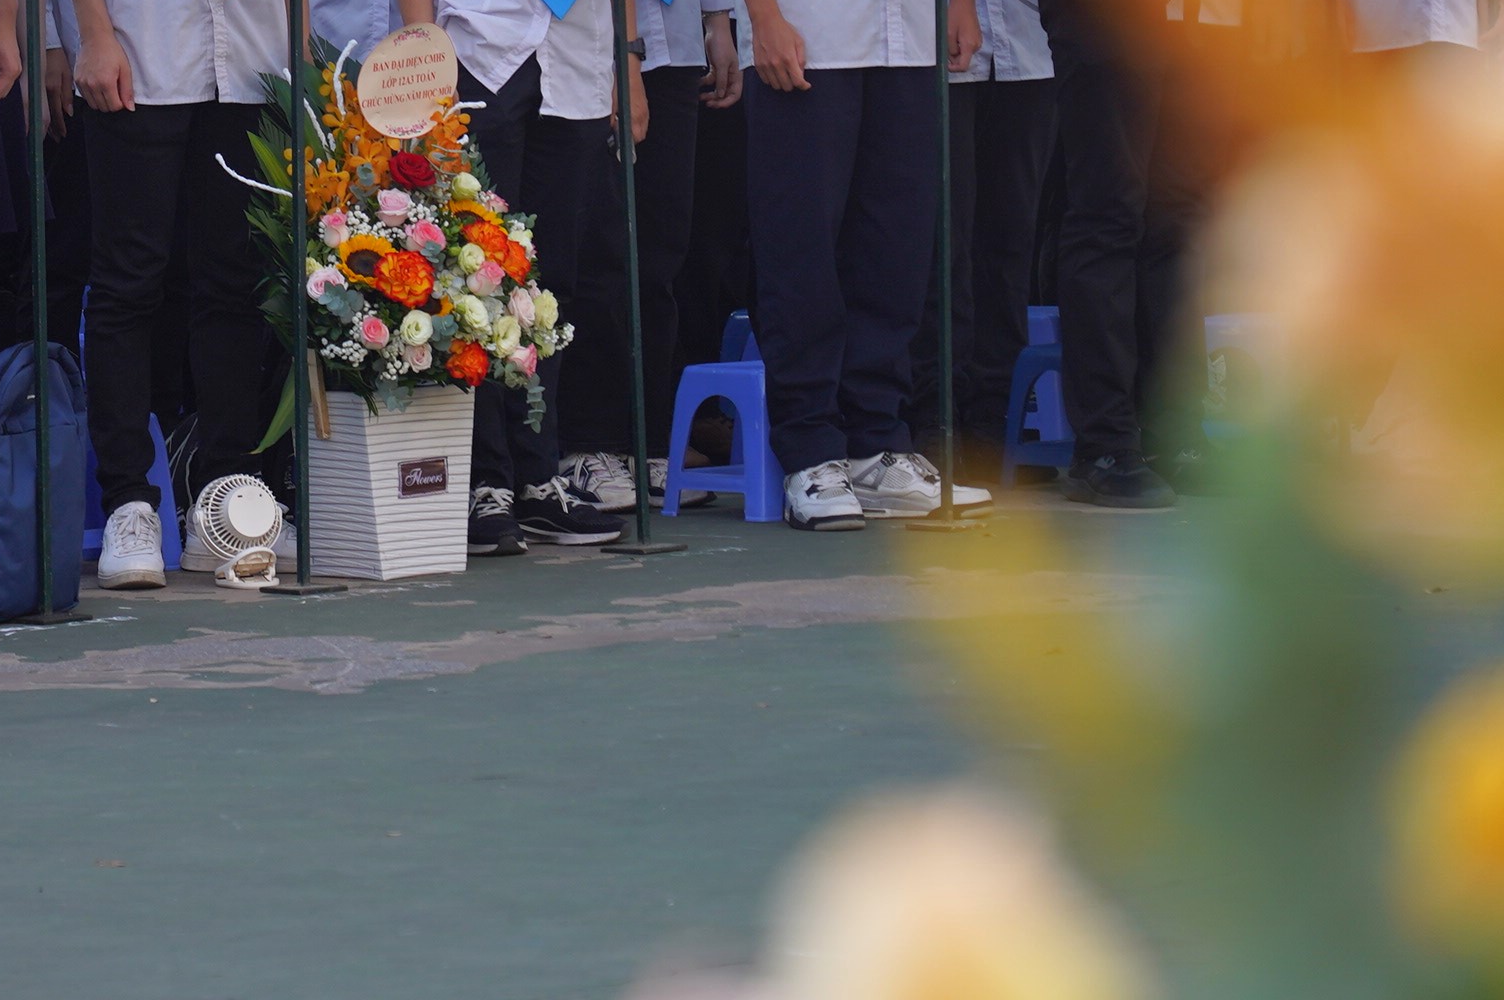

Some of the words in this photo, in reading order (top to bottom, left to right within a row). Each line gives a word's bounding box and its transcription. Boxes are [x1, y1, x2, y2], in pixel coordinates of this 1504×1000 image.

[373, 61, 390, 72] BAN
[424, 52, 446, 64] CMHS
[398, 76, 415, 87] 12A3
[416, 69, 436, 83] TOÁN
[404, 467, 443, 487] Flowers
